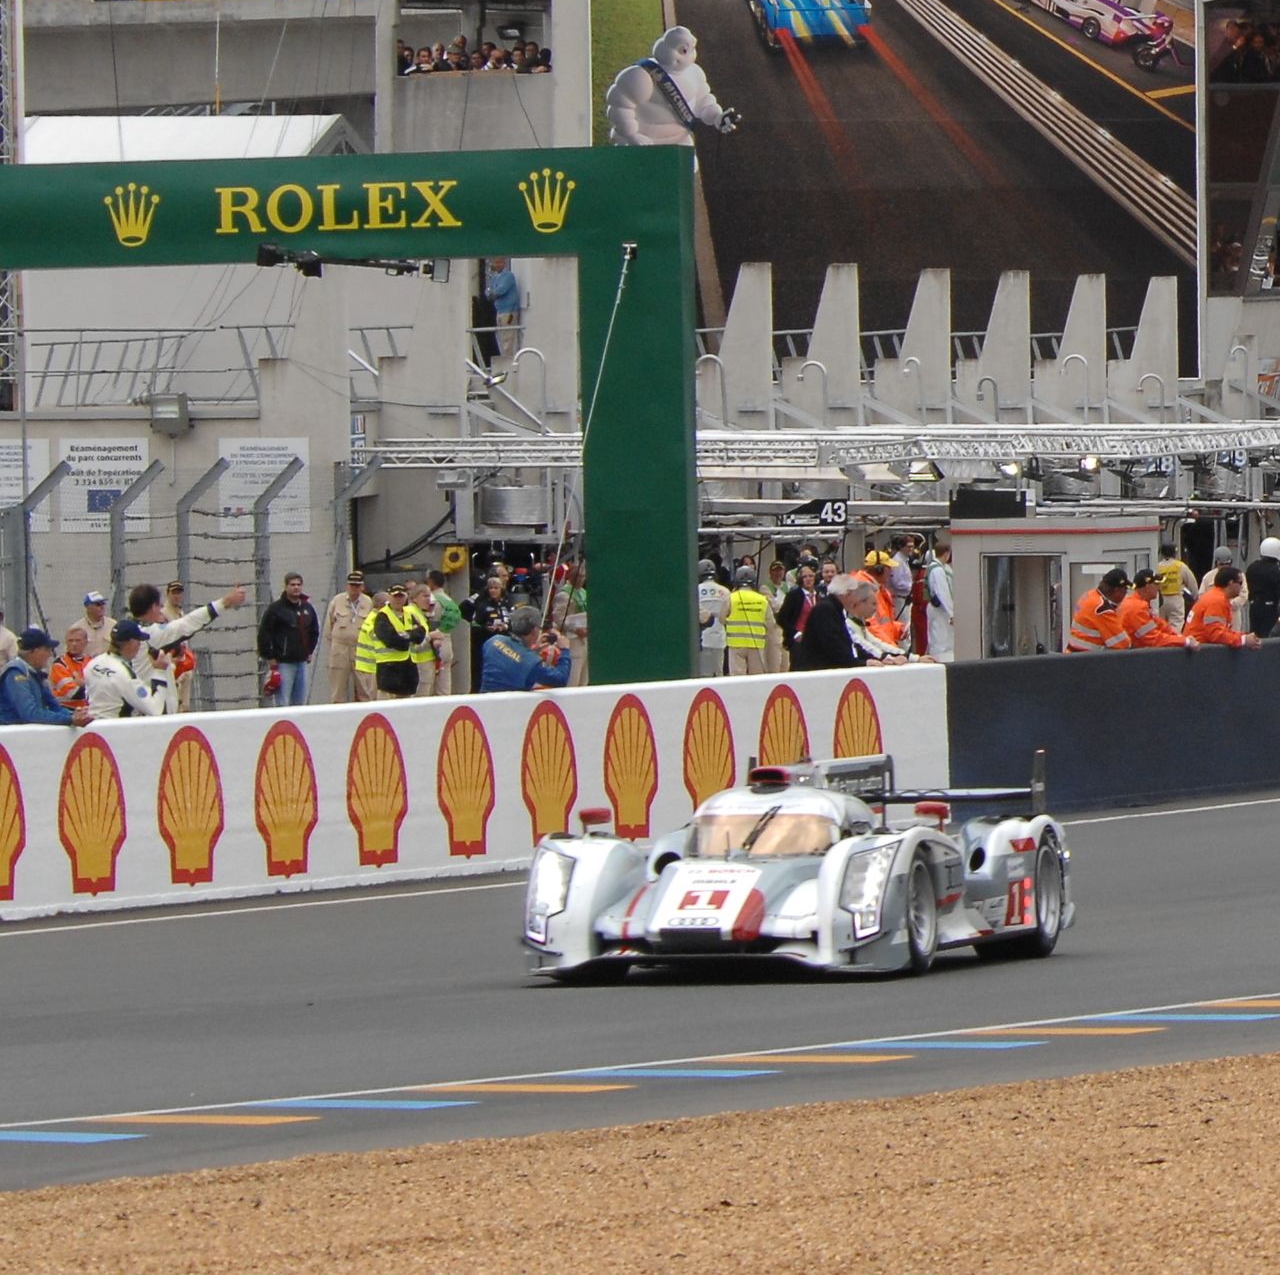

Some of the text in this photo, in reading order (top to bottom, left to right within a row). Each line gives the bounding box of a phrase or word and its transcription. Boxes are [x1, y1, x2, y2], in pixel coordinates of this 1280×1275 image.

[215, 180, 463, 235] ROLEX
[70, 444, 138, 453] Réaménagement
[78, 455, 94, 463] parc
[821, 502, 846, 523] 43
[683, 891, 717, 910] 1
[1009, 883, 1022, 924] 1
